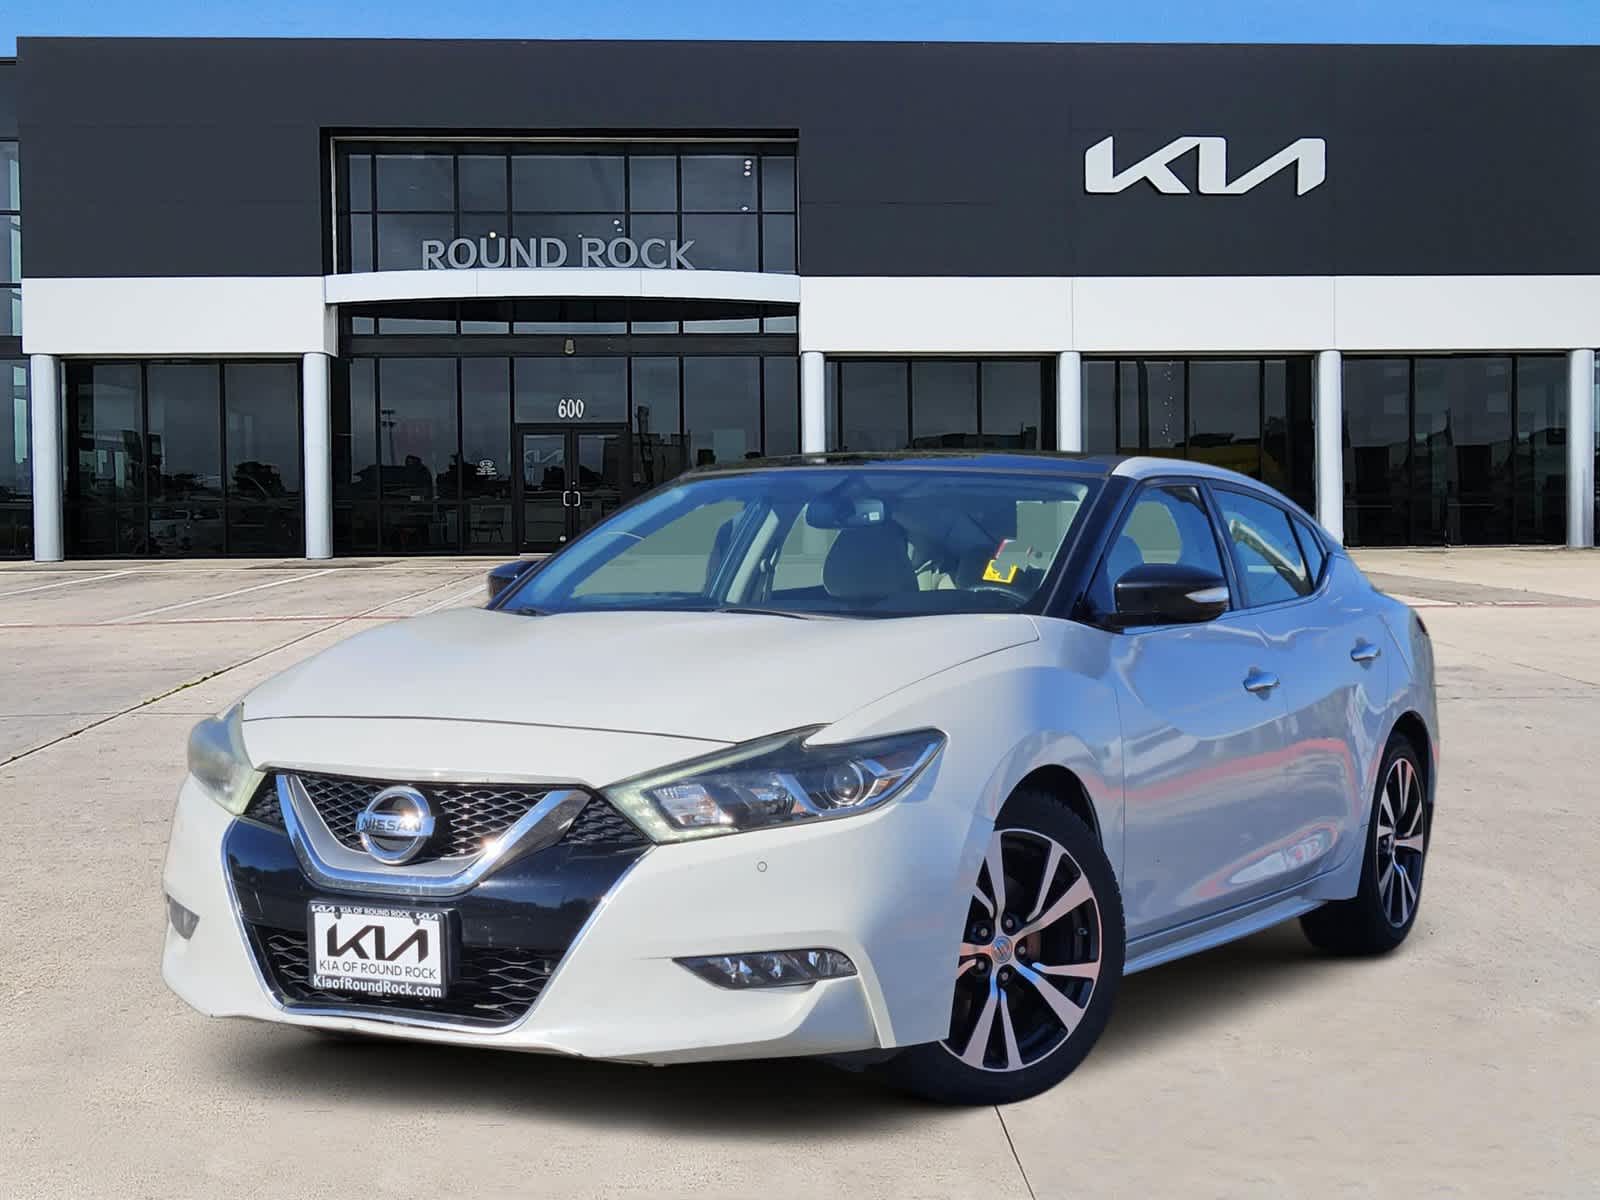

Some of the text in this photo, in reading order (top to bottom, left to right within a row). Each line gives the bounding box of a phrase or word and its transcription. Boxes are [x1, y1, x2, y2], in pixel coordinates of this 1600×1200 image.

[1085, 136, 1326, 195] KIA
[422, 238, 696, 270] ROUND ROCK
[558, 399, 584, 418] 600
[327, 923, 428, 963] KIA
[319, 960, 437, 979] KIA OF ROUND ROCK
[313, 974, 442, 997] KiaofRoundRock.com
